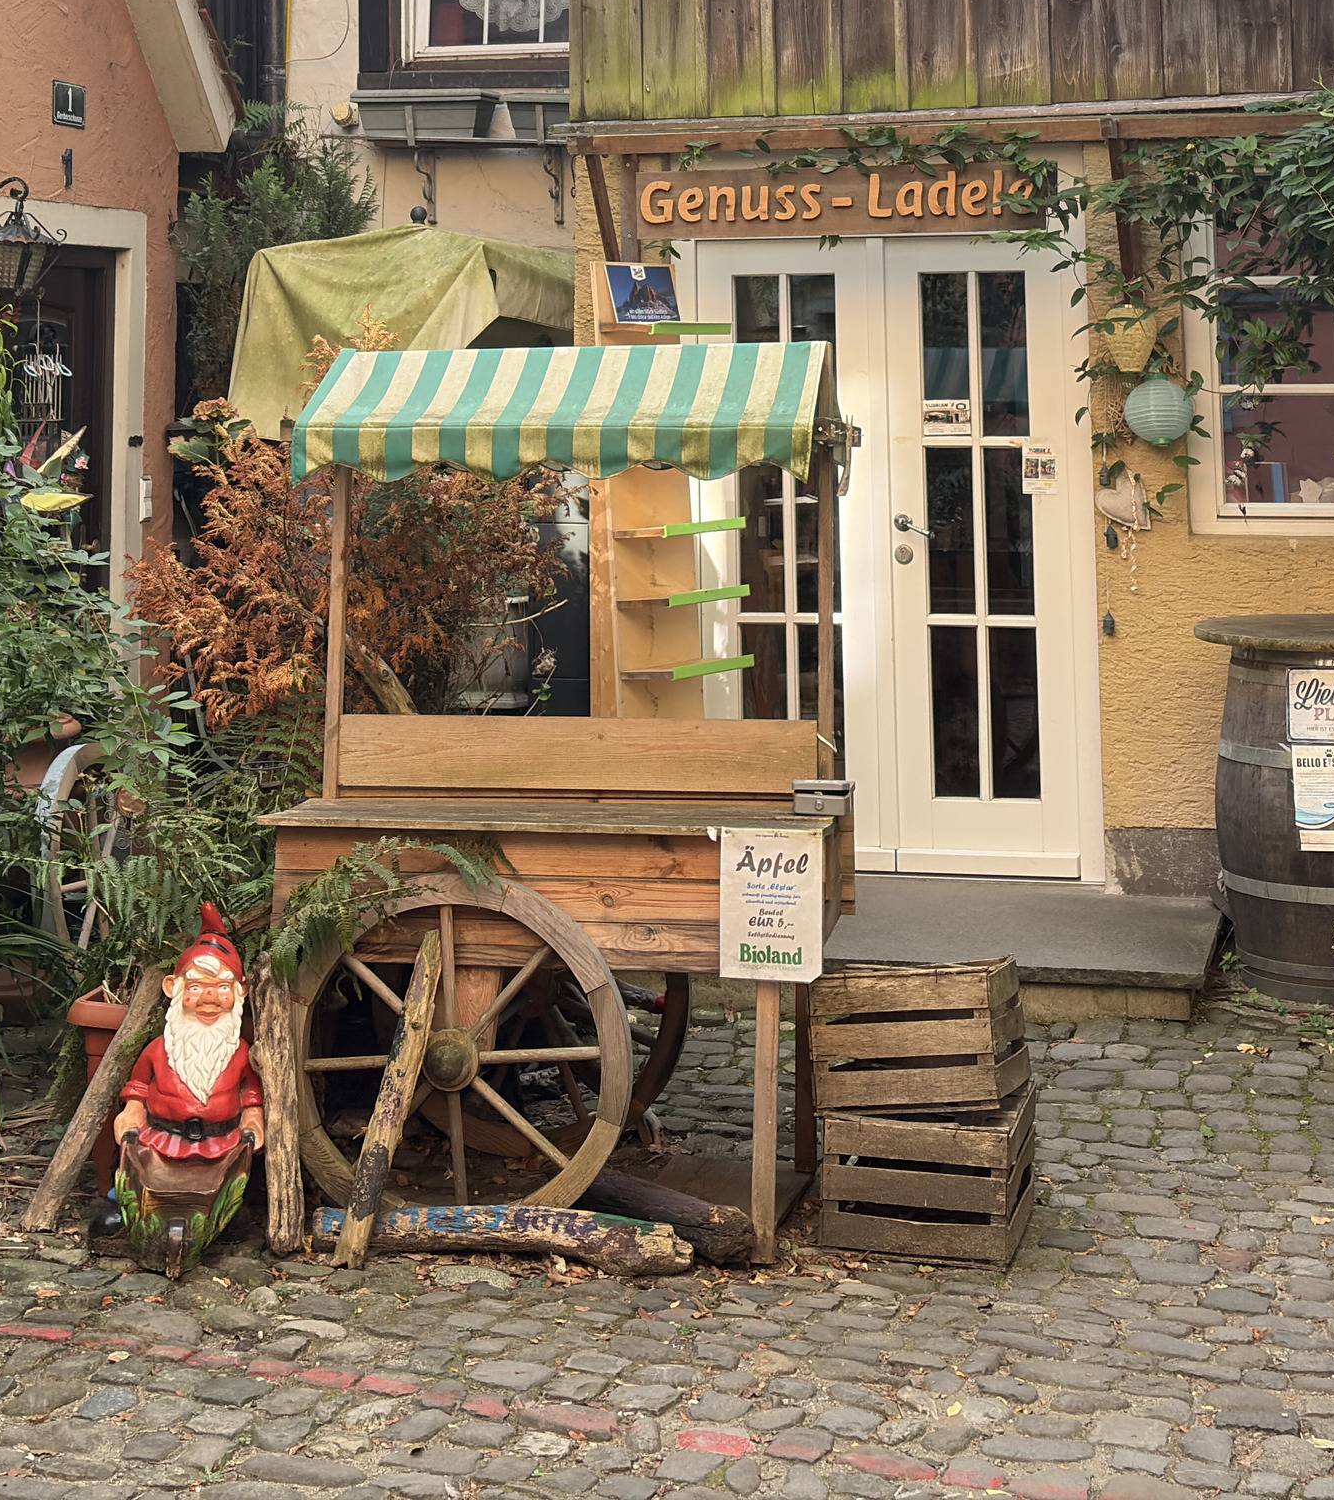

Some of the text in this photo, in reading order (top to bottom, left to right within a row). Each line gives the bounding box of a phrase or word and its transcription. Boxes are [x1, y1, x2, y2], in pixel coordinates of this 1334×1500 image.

[67, 87, 73, 112] 1
[1296, 758, 1321, 768] BELLO
[735, 845, 809, 878] Äpfel
[746, 881, 765, 890] Sorte
[759, 908, 784, 916] Beutel
[748, 916, 774, 927] EUR
[747, 931, 795, 940] Selbstbedienung
[739, 943, 802, 965] Bioland
